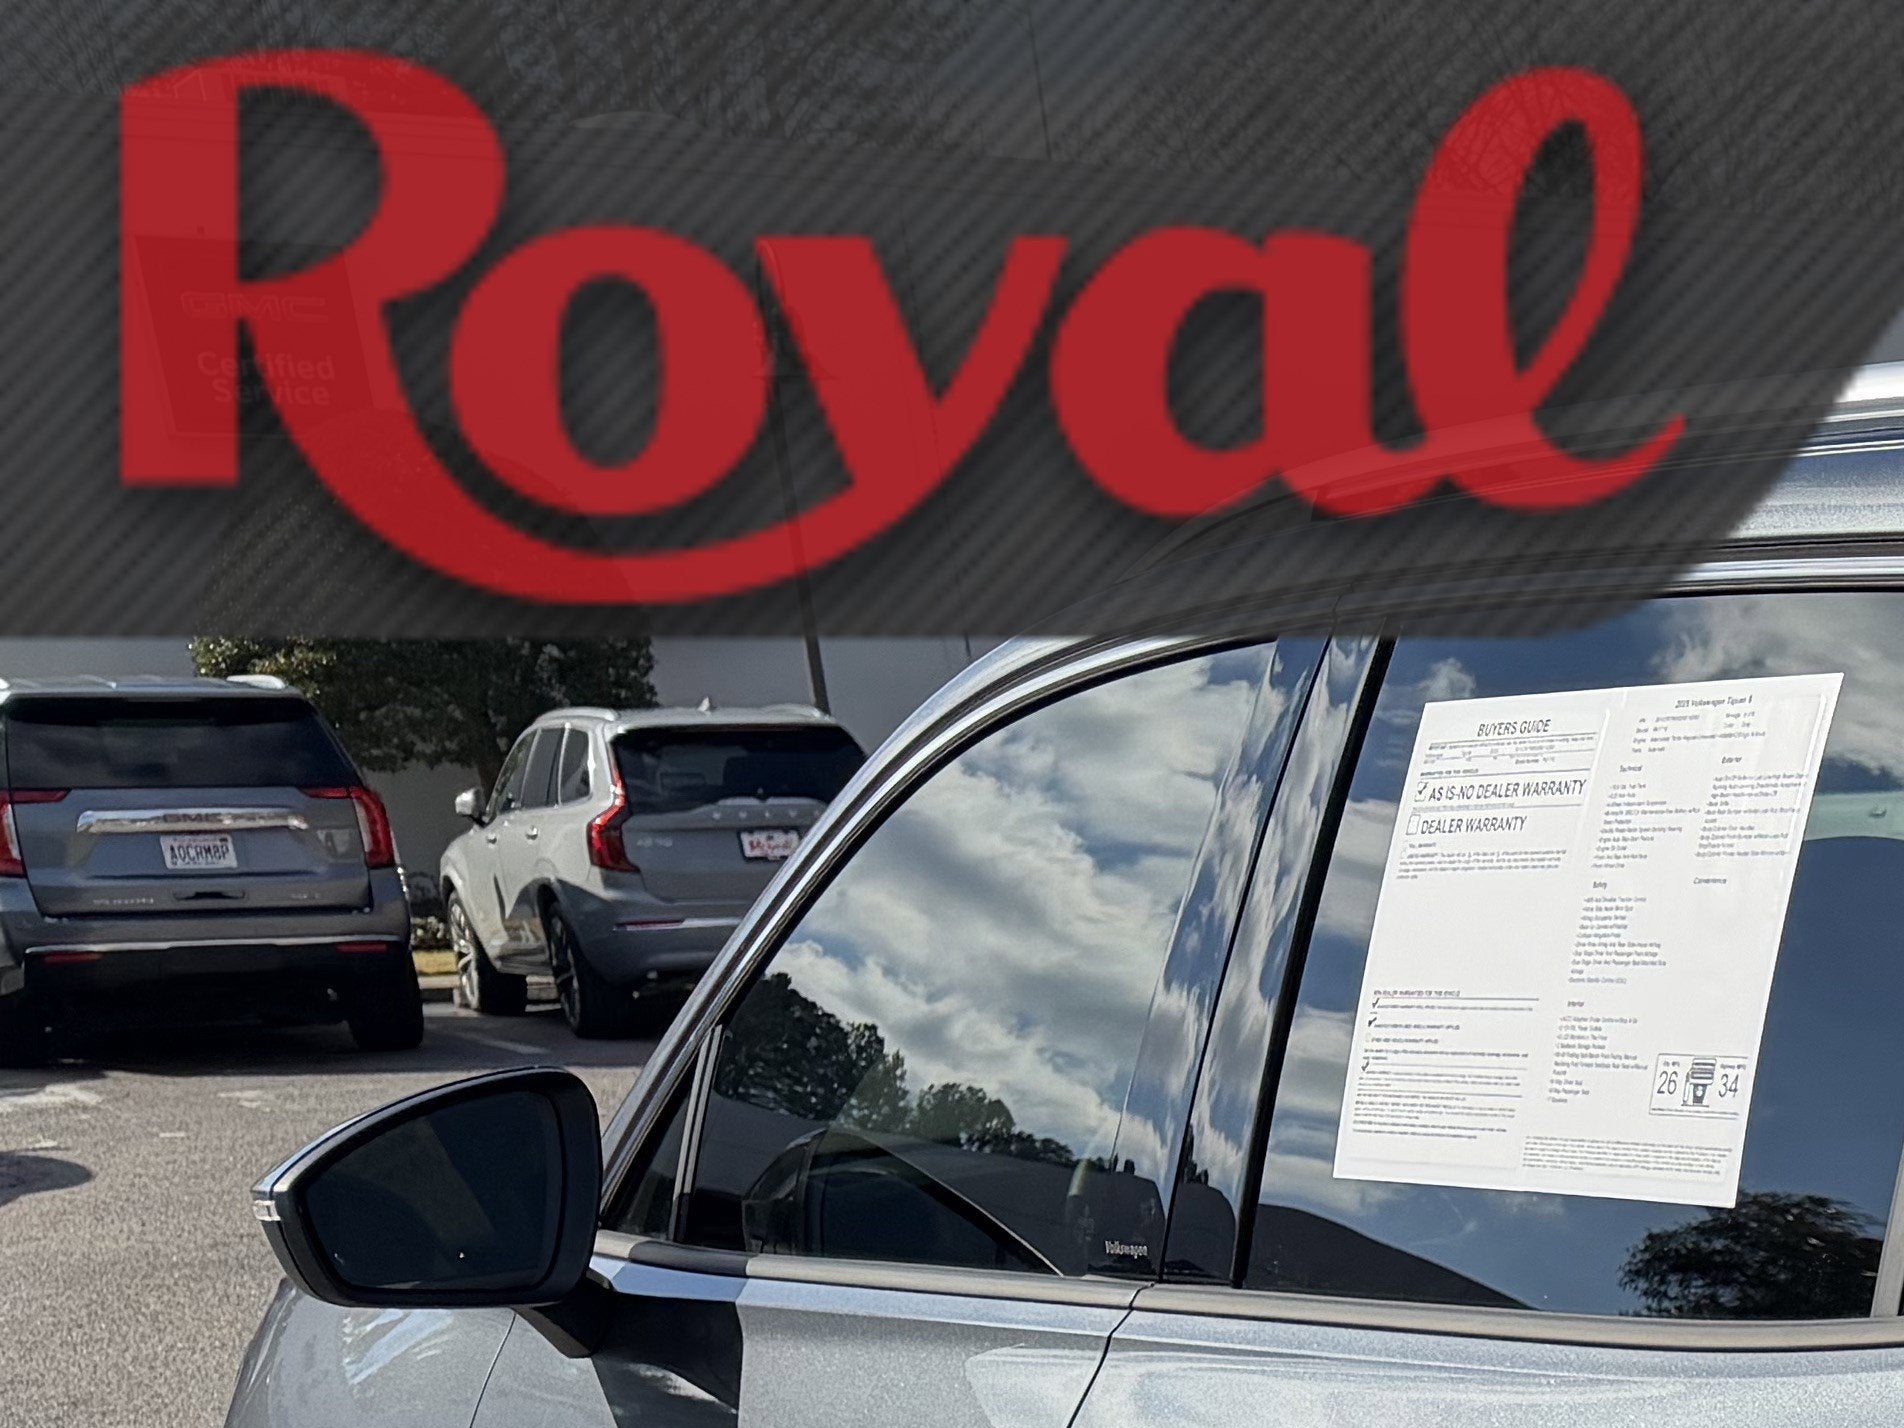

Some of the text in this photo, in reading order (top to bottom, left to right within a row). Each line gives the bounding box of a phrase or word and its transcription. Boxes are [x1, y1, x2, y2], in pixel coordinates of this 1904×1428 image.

[1477, 718, 1552, 737] BUYERS GUIDE
[1428, 786, 1443, 802] AS
[1476, 782, 1520, 800] DEALER
[1522, 779, 1587, 797] WARRANTY
[1420, 815, 1528, 835] DEALER WARRANTY
[1656, 1070, 1679, 1095] 26
[1718, 1072, 1740, 1099] 34
